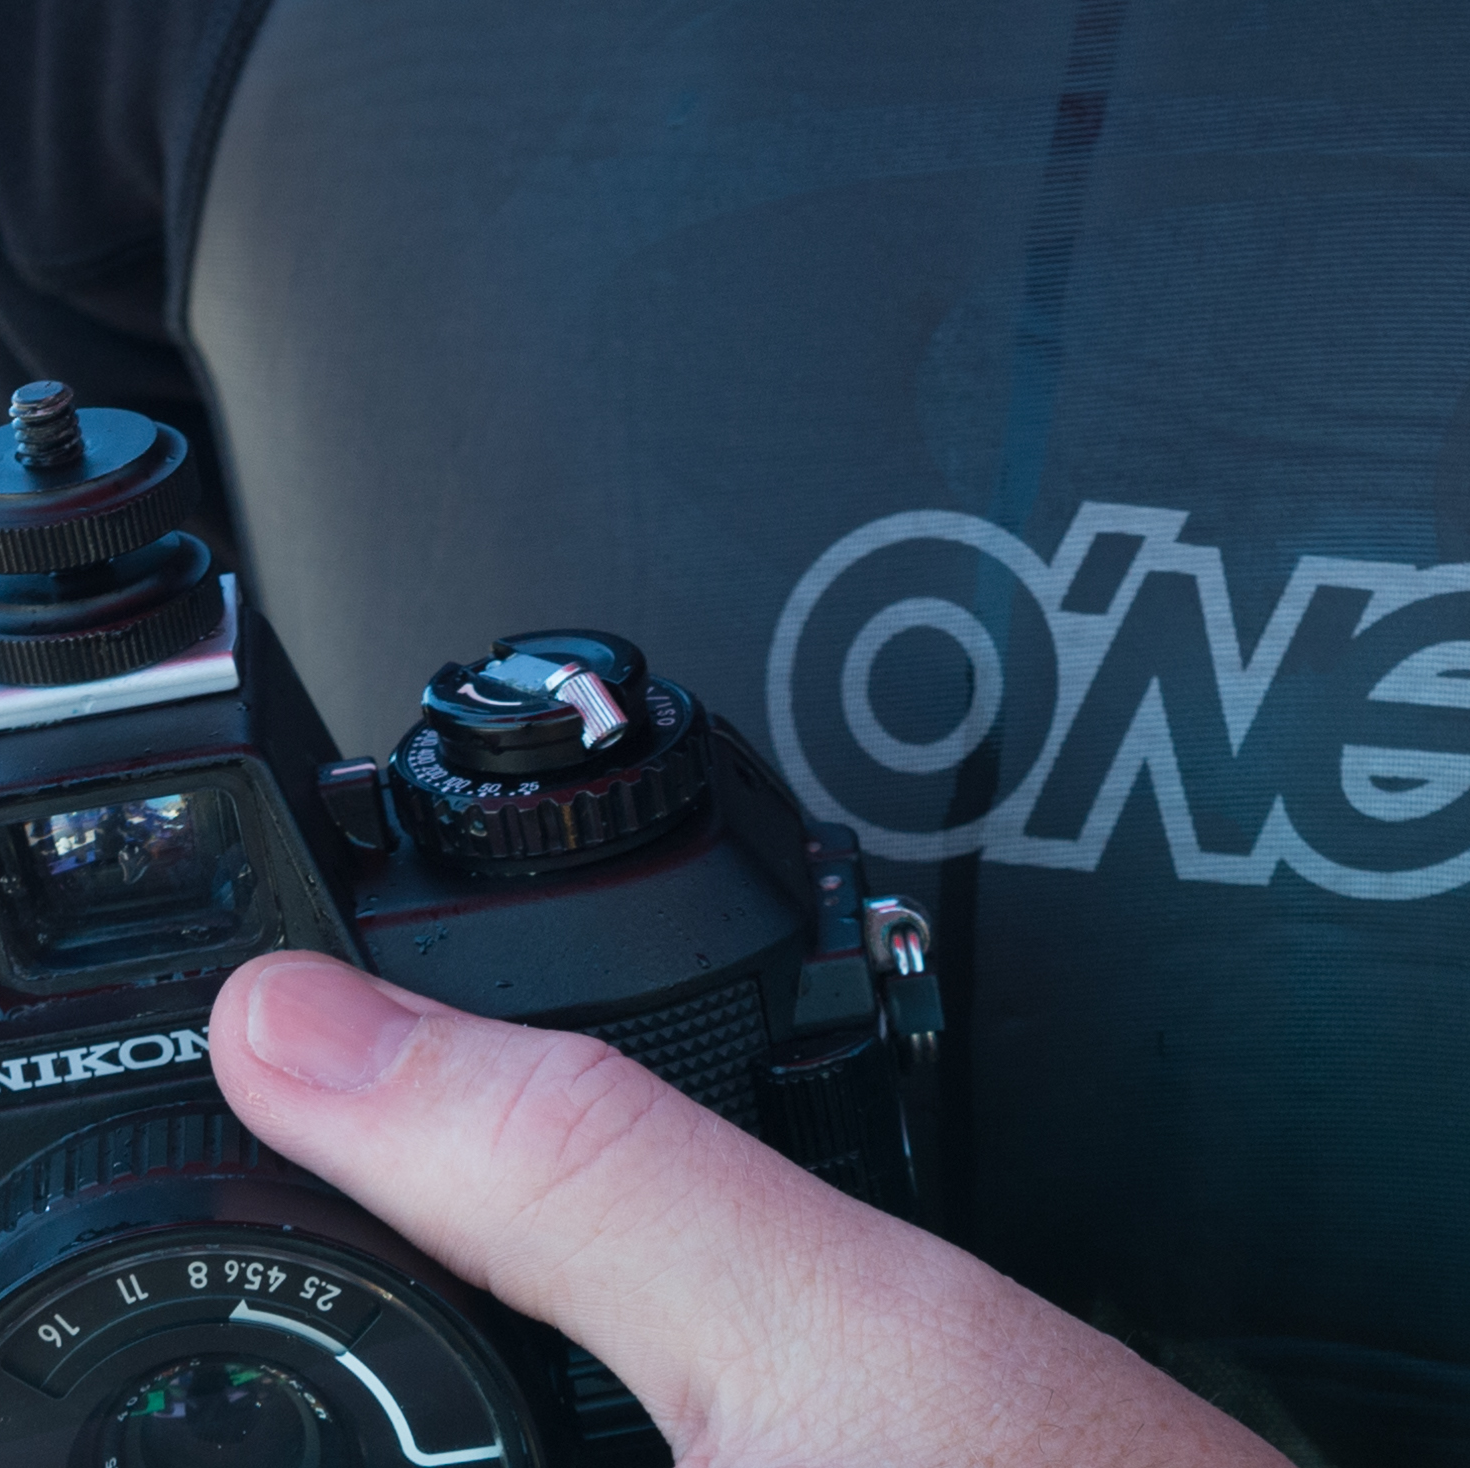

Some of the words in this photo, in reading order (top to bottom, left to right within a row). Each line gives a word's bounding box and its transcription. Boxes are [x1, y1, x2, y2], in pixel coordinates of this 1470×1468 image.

[421, 763, 449, 781] 200
[442, 776, 472, 790] 100
[477, 782, 503, 794] 50
[518, 781, 540, 794] 25
[186, 1260, 209, 1291] 8
[116, 1272, 150, 1306] 11
[299, 1274, 343, 1313] 2.5
[36, 1311, 82, 1349] 16
